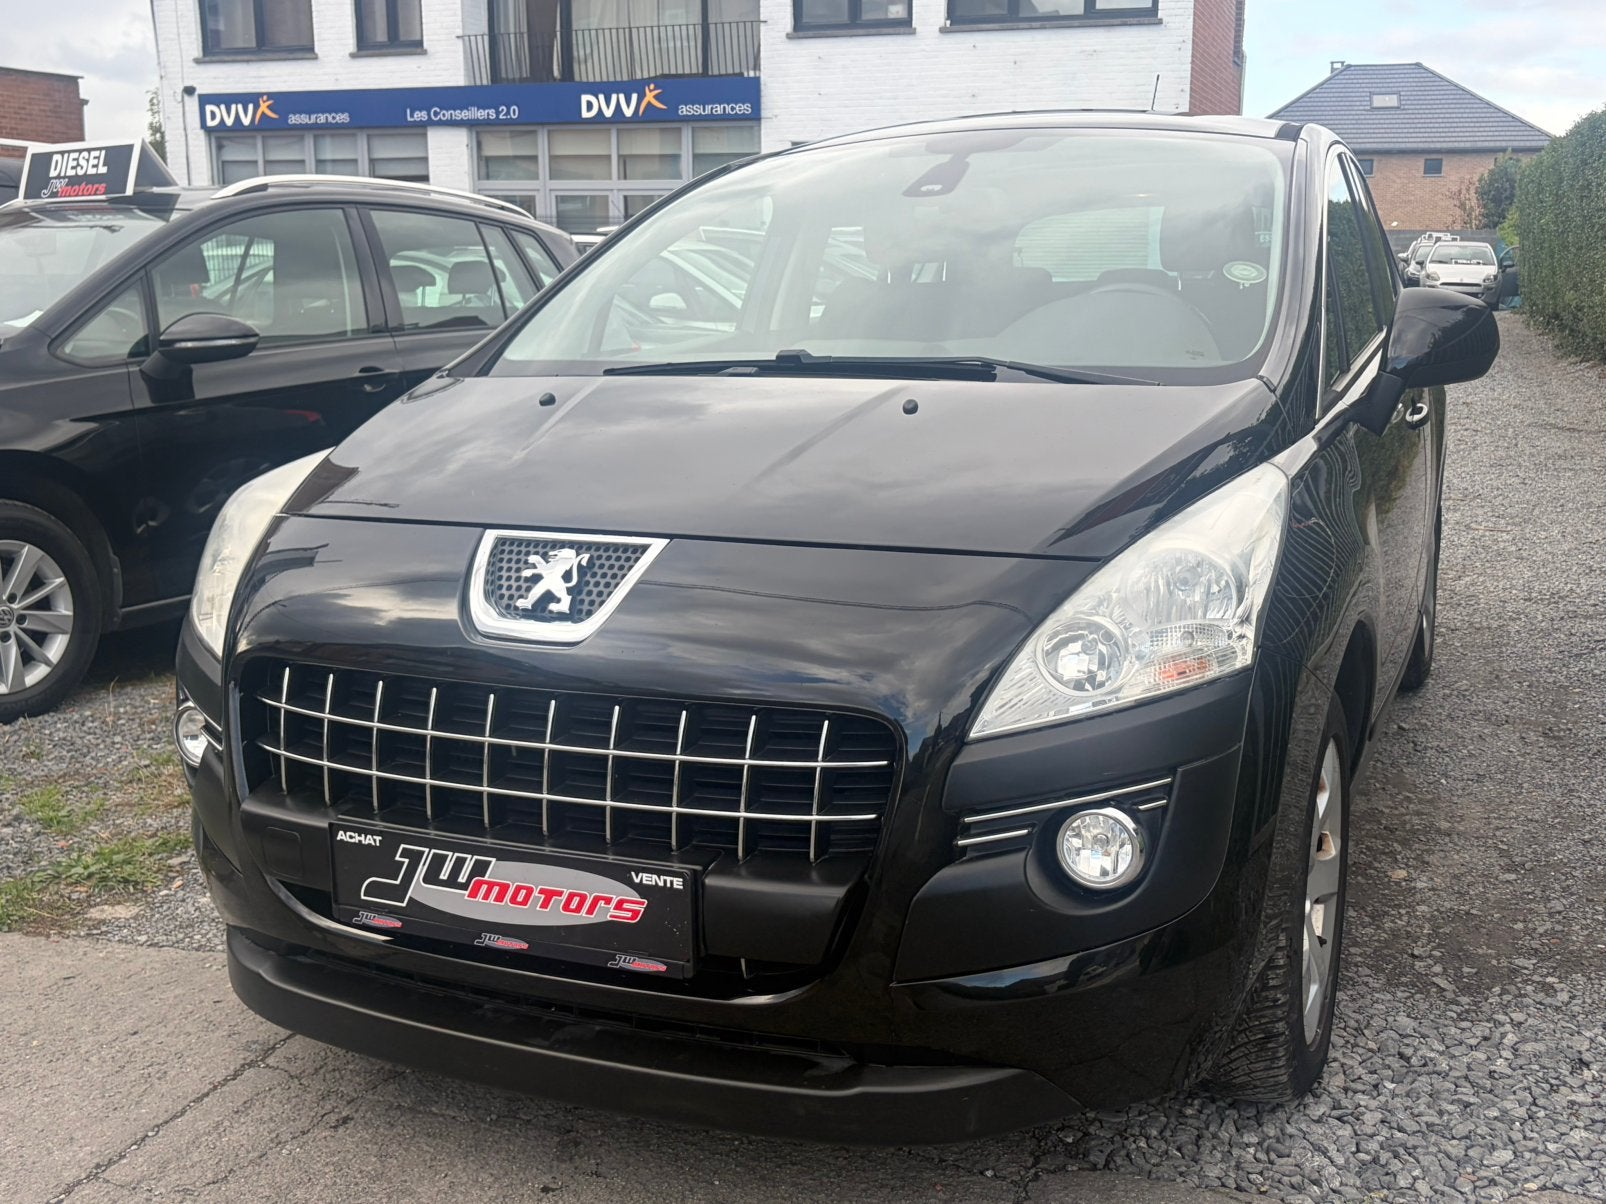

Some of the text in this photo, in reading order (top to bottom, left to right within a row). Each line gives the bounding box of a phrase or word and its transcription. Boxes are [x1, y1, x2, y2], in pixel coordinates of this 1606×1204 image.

[205, 103, 350, 127] DVV assurances
[406, 105, 519, 121] Les Conseillers 2.0
[581, 93, 752, 118] DVV assurances
[49, 150, 108, 178] DIESEL
[58, 182, 107, 198] motors
[336, 830, 382, 847] ACHAT
[360, 844, 496, 907] JW
[630, 871, 684, 890] VENTE
